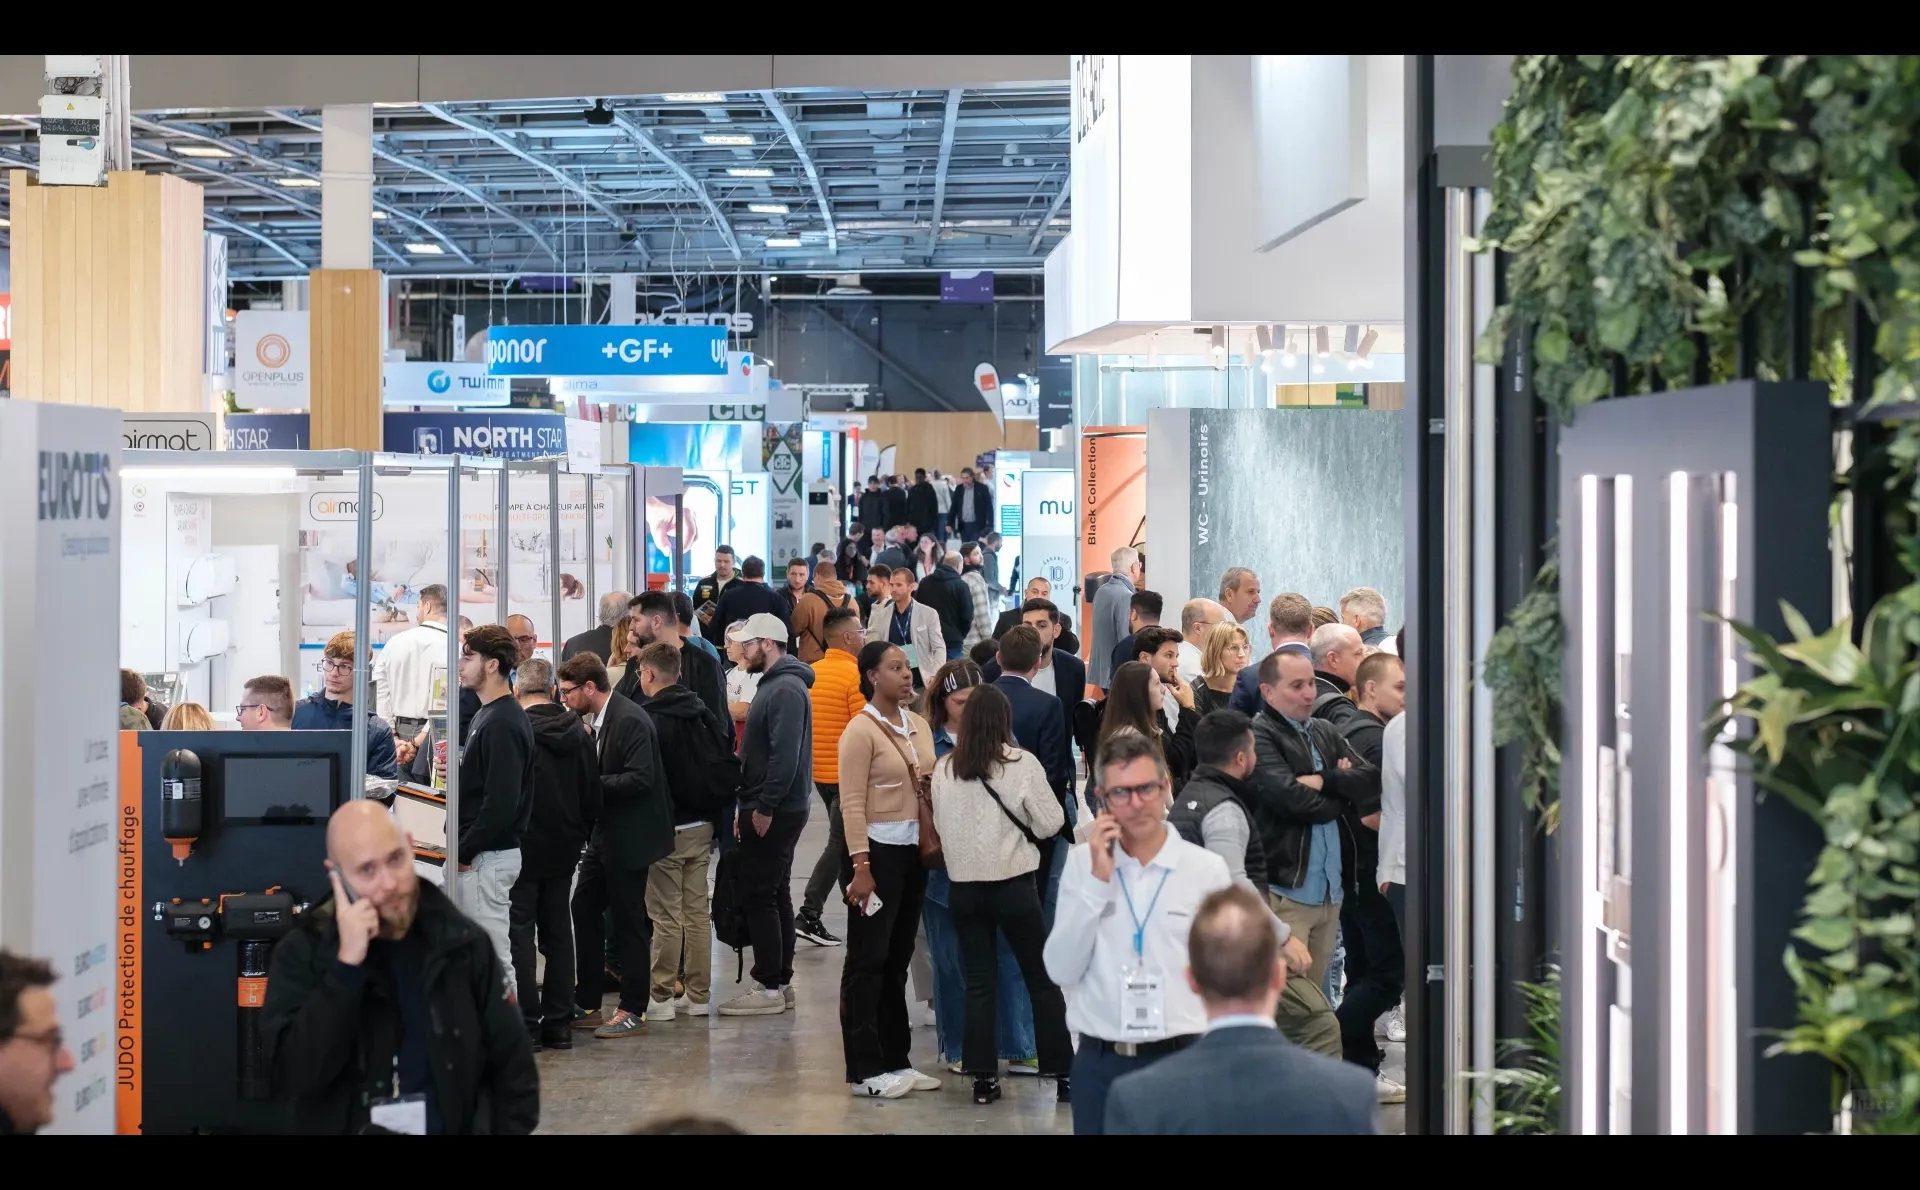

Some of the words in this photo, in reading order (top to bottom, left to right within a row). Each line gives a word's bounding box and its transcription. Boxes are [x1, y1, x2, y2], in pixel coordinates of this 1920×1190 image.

[602, 338, 673, 363] +GF+
[242, 371, 304, 382] OPENPLUS
[453, 426, 533, 449] NORTH
[537, 427, 563, 449] STAR
[774, 455, 791, 470] CTC
[1087, 438, 1097, 505] Collection
[1198, 424, 1209, 496] Urinoirs
[494, 503, 524, 511] PMPE
[1087, 508, 1097, 545] Black
[1198, 513, 1209, 546] WC
[1049, 566, 1064, 581] 10
[118, 805, 139, 899] chauffage
[118, 904, 135, 927] de
[118, 931, 135, 1030] Protection
[118, 1036, 135, 1091] JUDO
